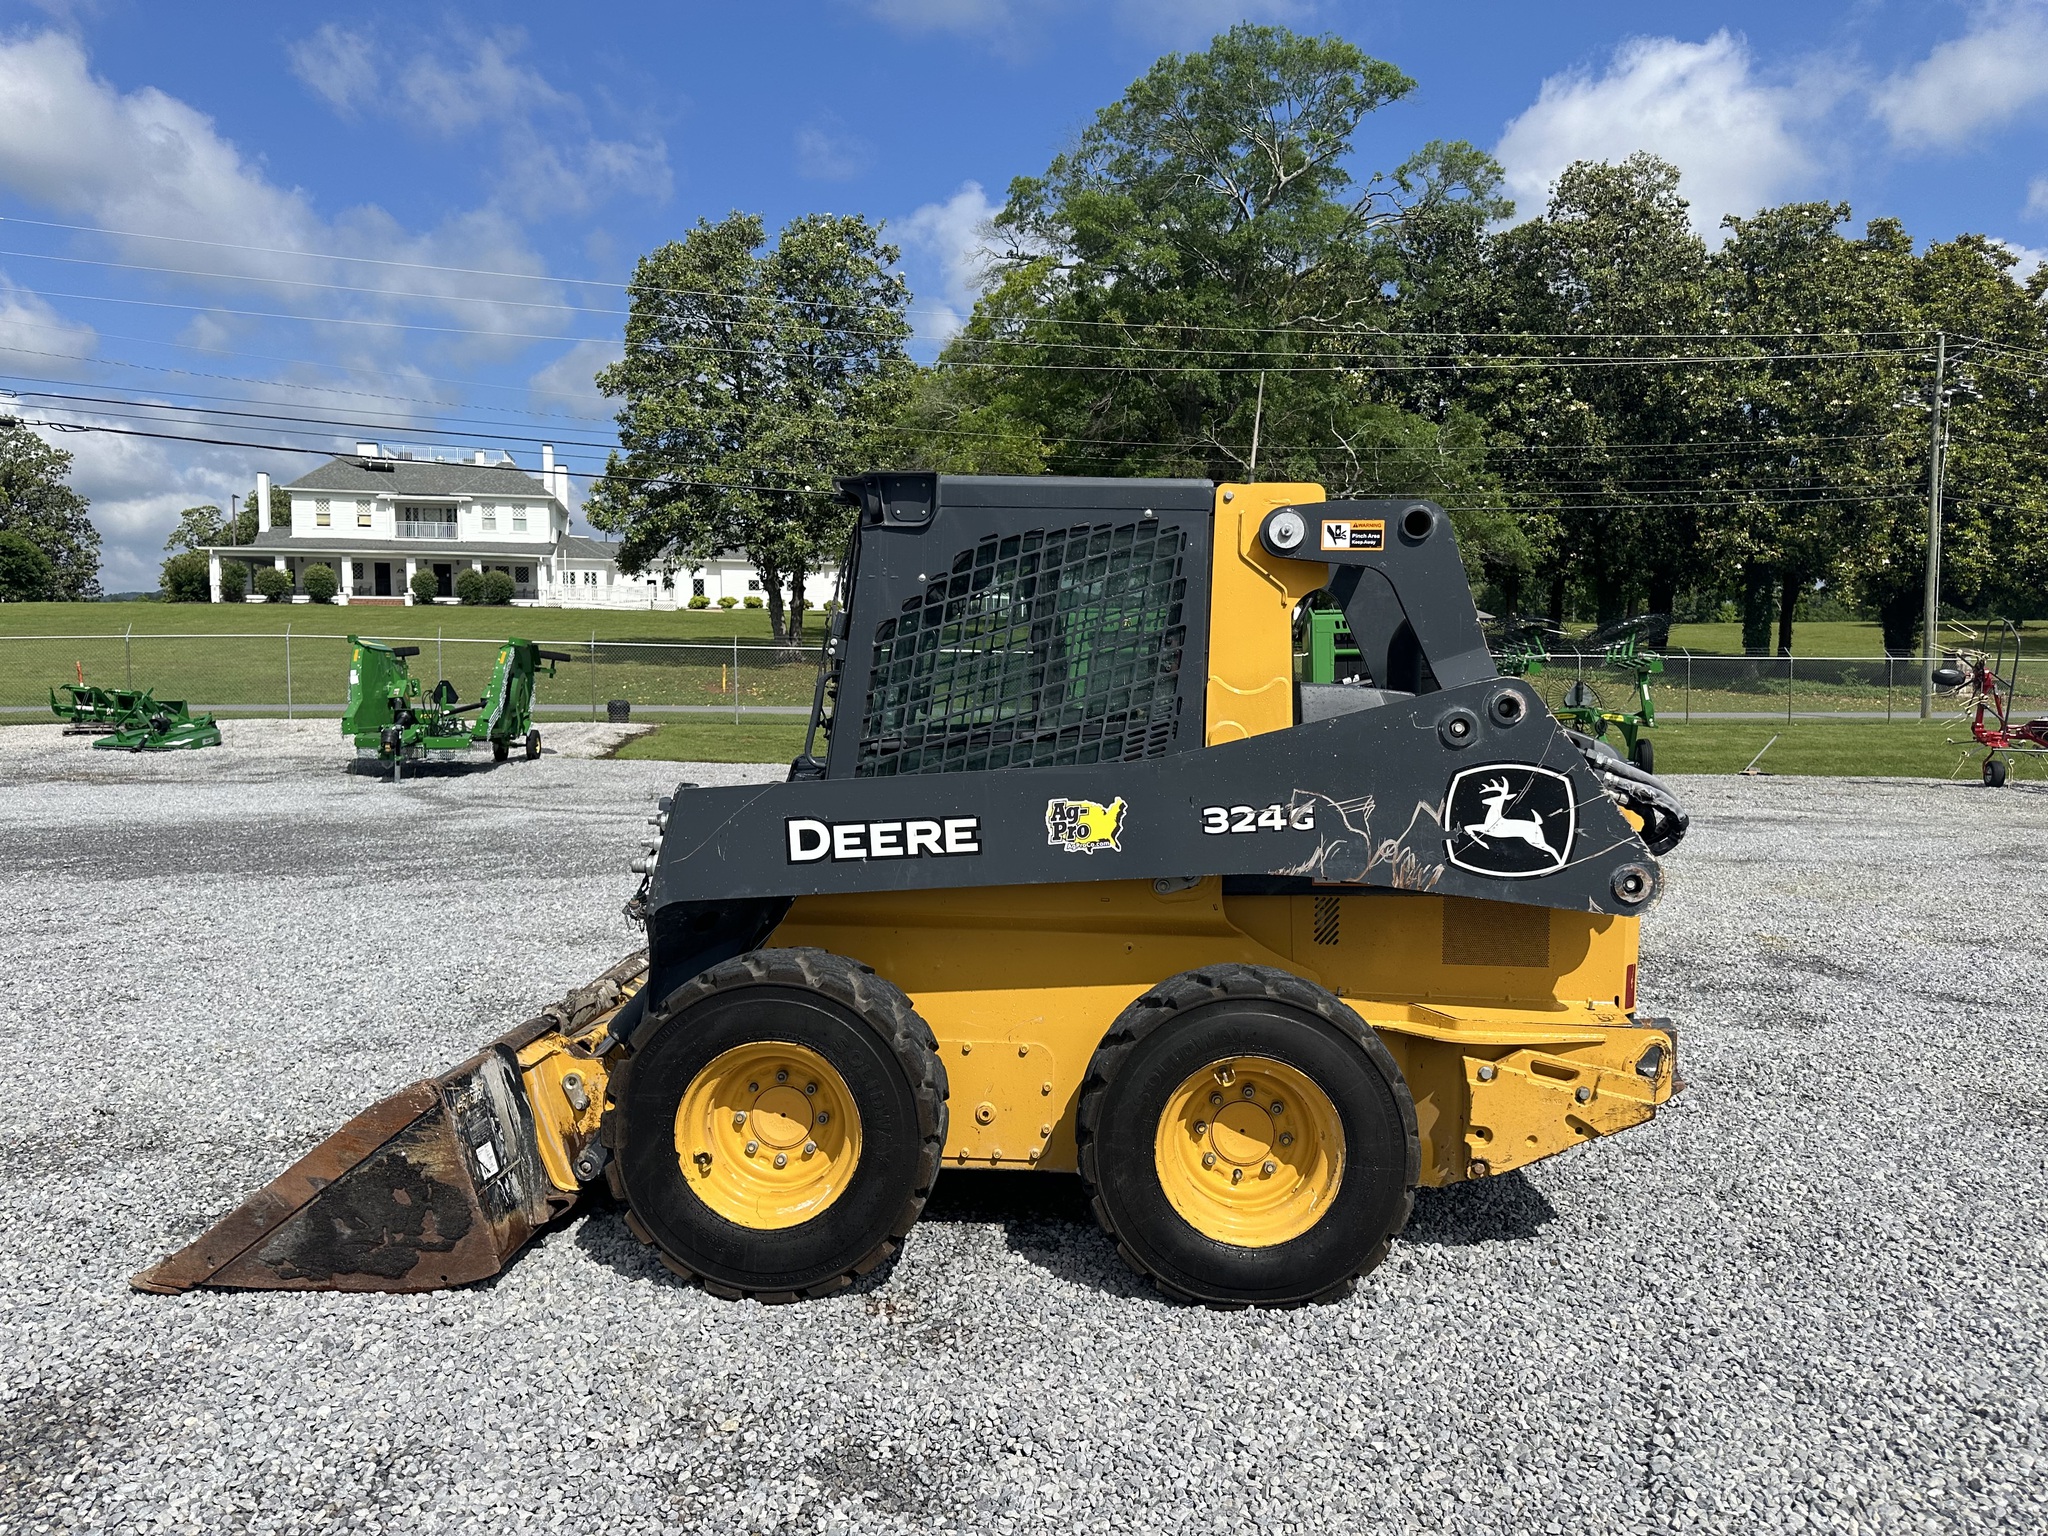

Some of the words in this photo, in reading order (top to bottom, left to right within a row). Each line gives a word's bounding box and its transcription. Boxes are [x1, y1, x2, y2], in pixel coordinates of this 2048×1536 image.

[1050, 802, 1088, 824] Ag-
[1203, 804, 1314, 833] 324G
[788, 817, 979, 861] DEERE
[1052, 821, 1090, 841] Pro
